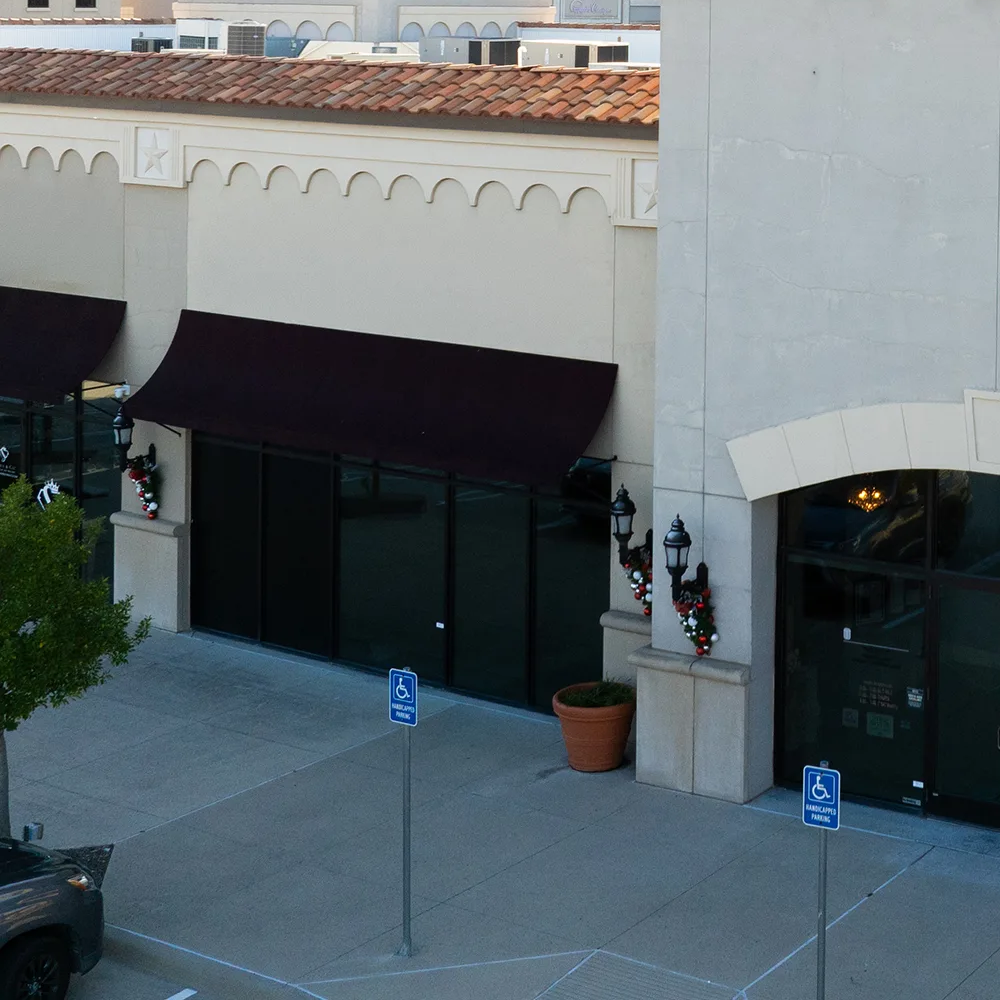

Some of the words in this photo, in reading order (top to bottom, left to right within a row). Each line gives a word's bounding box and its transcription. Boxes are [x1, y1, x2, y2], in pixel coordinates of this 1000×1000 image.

[392, 703, 415, 713] HANDICAPPED
[396, 711, 411, 720] PARKING
[806, 804, 837, 816] HANDICAPPED
[811, 813, 831, 823] PARKING
